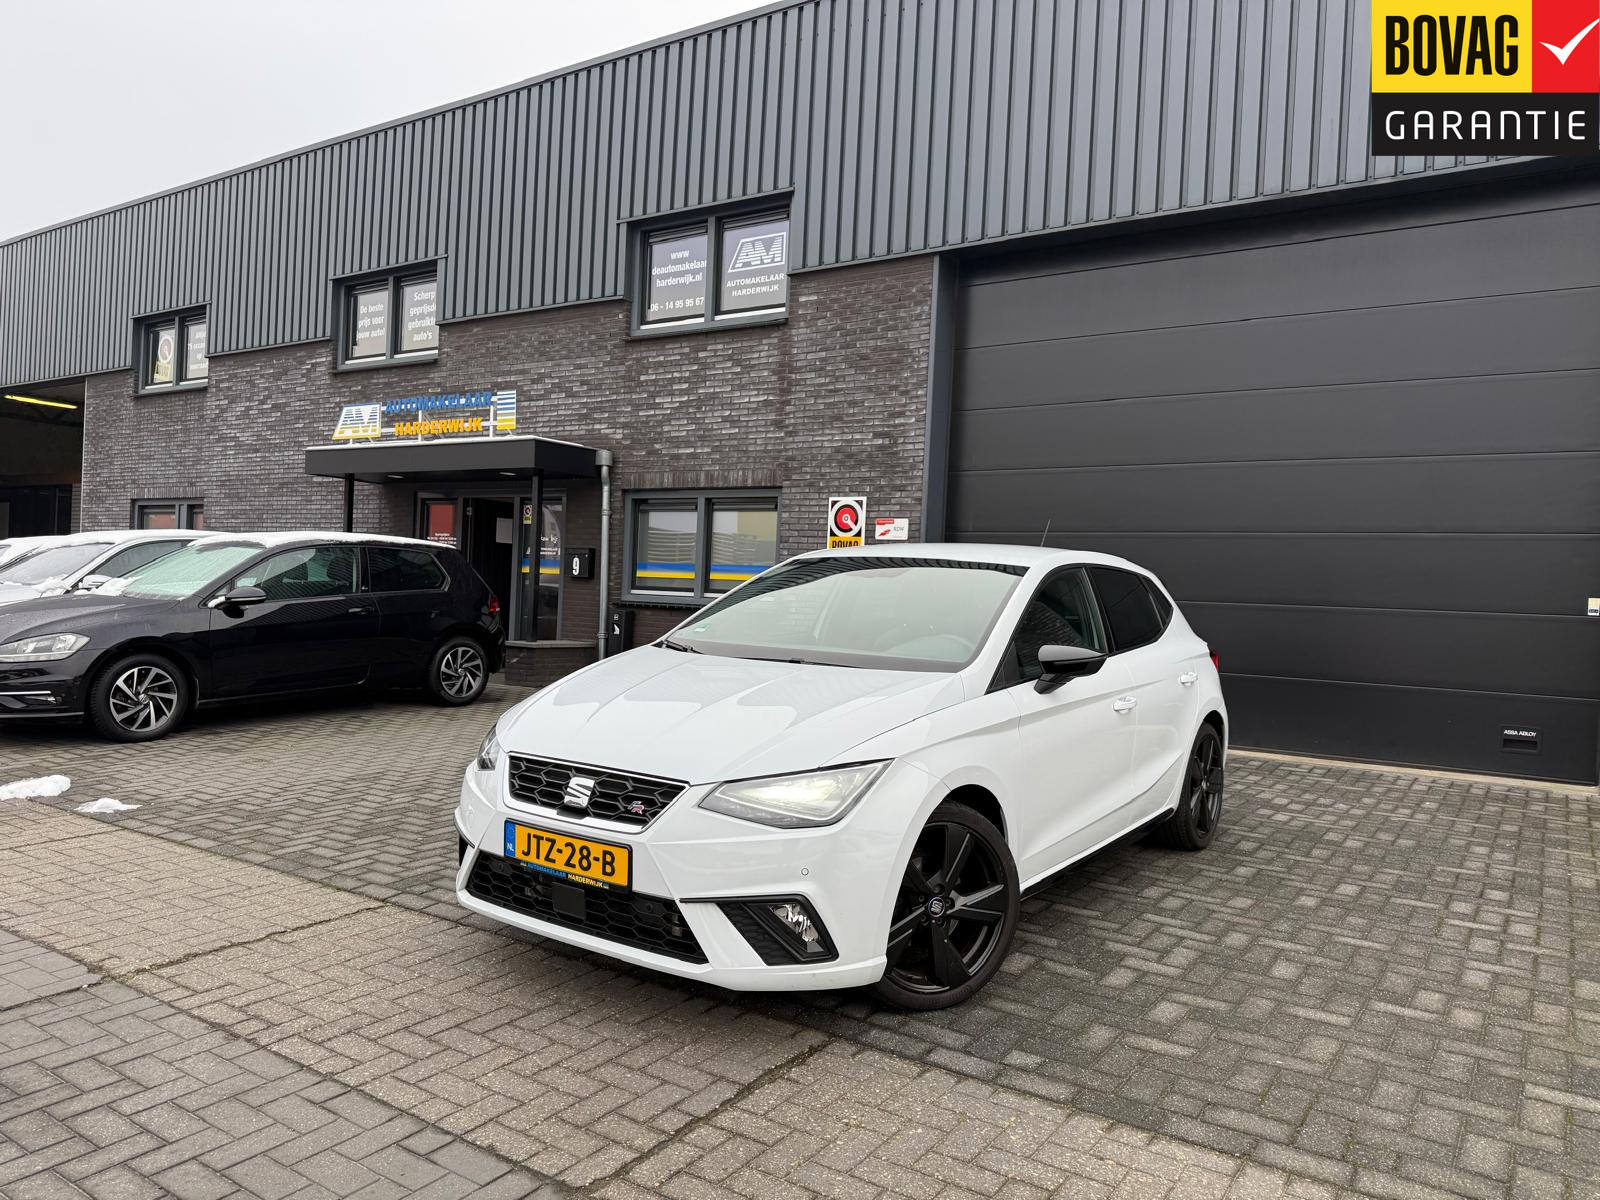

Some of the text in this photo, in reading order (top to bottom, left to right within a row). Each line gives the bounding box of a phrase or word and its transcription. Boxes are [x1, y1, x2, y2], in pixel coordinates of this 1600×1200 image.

[670, 250, 689, 260] www
[656, 272, 702, 287] harderwijk.nl
[726, 273, 785, 288] AUTOMAKELAAR
[732, 285, 779, 297] HARDERWIJK
[360, 303, 384, 314] De beste
[650, 303, 659, 311] 06
[665, 301, 674, 310] 14
[675, 300, 684, 309] 95
[685, 299, 694, 308] 95
[695, 297, 705, 306] 67
[358, 316, 385, 329] prijs voor
[413, 331, 433, 341] auto's
[385, 391, 493, 415] AUTOMAKELAAR
[394, 417, 484, 437] HARDERWIJK
[572, 557, 580, 575] 9
[506, 842, 514, 852] NL
[521, 832, 616, 877] JTZ-28-B
[567, 873, 603, 888] HARDERWIJK
